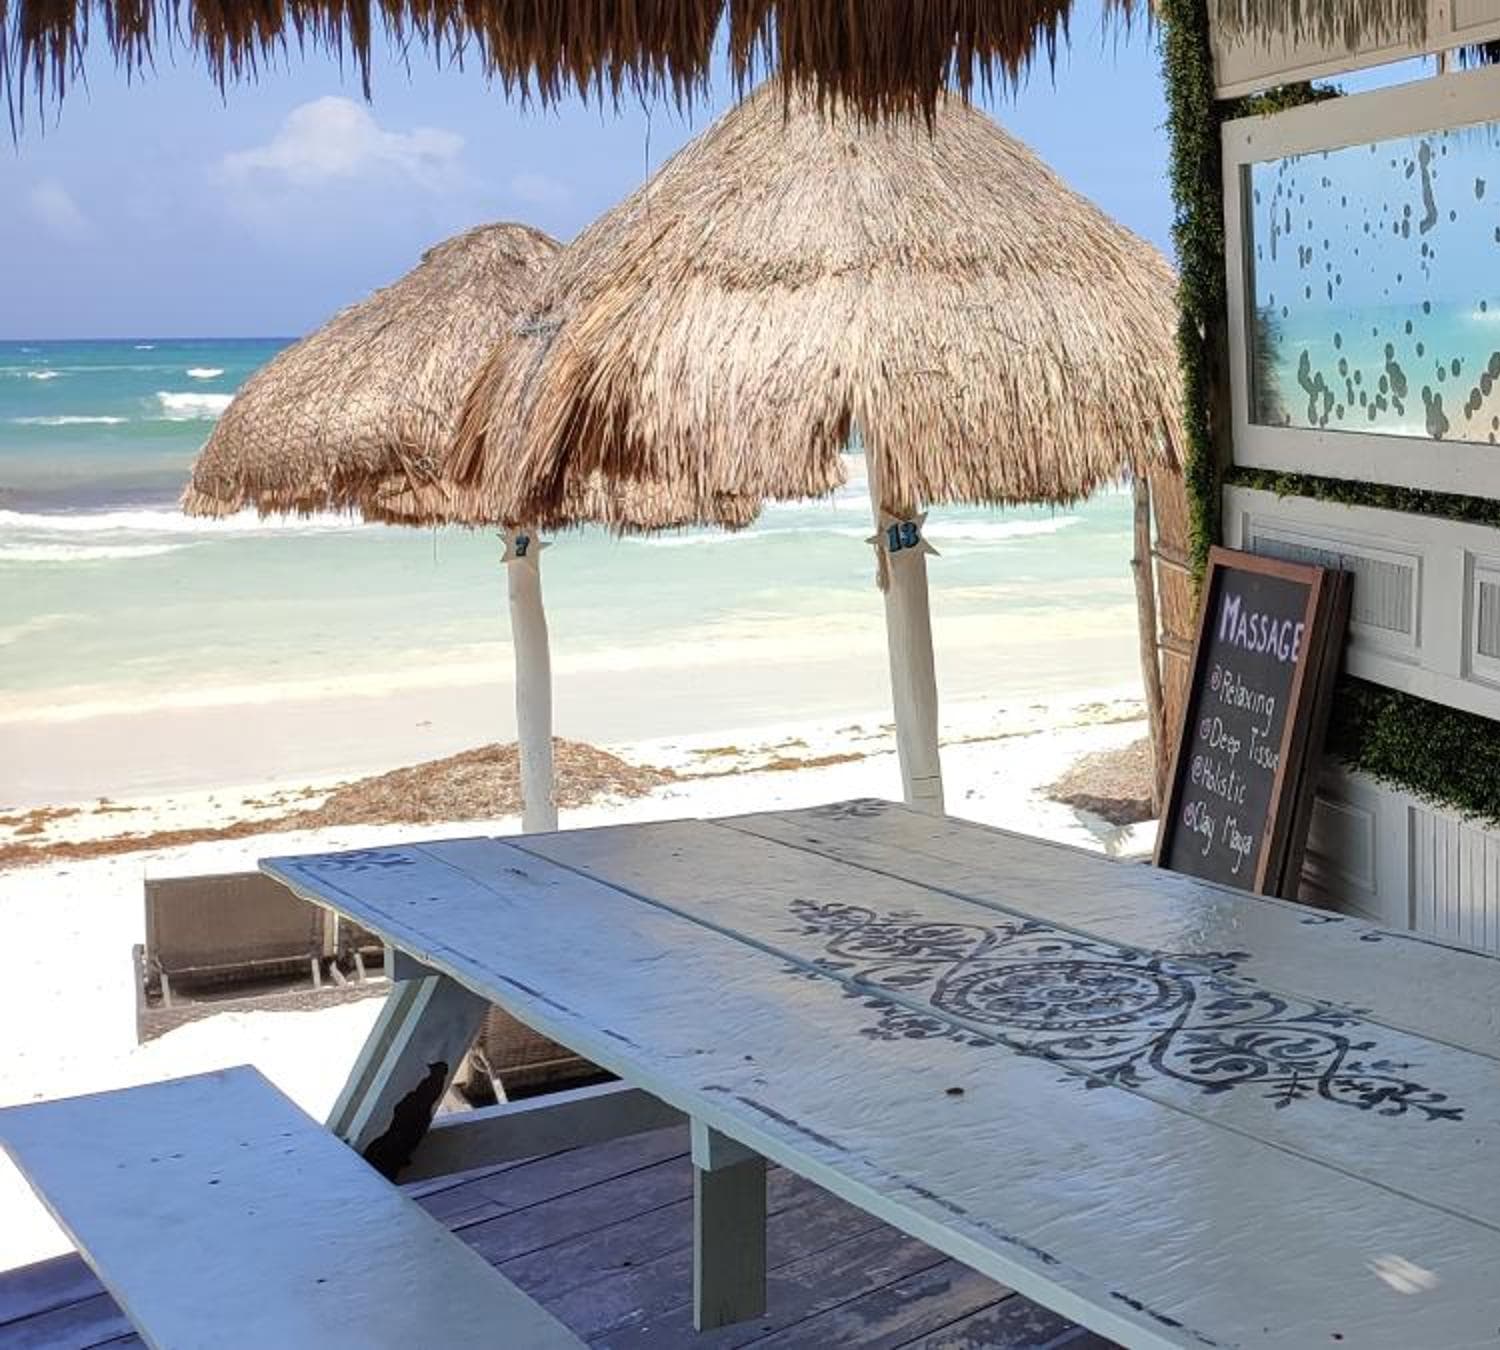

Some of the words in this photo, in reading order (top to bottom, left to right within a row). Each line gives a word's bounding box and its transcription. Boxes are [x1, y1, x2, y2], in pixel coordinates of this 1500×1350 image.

[886, 522, 920, 552] 13
[1219, 592, 1304, 661] MASSAGE
[1219, 669, 1275, 737] Relaxing
[1209, 716, 1240, 764] Deep
[1202, 756, 1246, 804] Holistic
[1194, 801, 1216, 857] Clay
[1221, 816, 1253, 874] Maya
